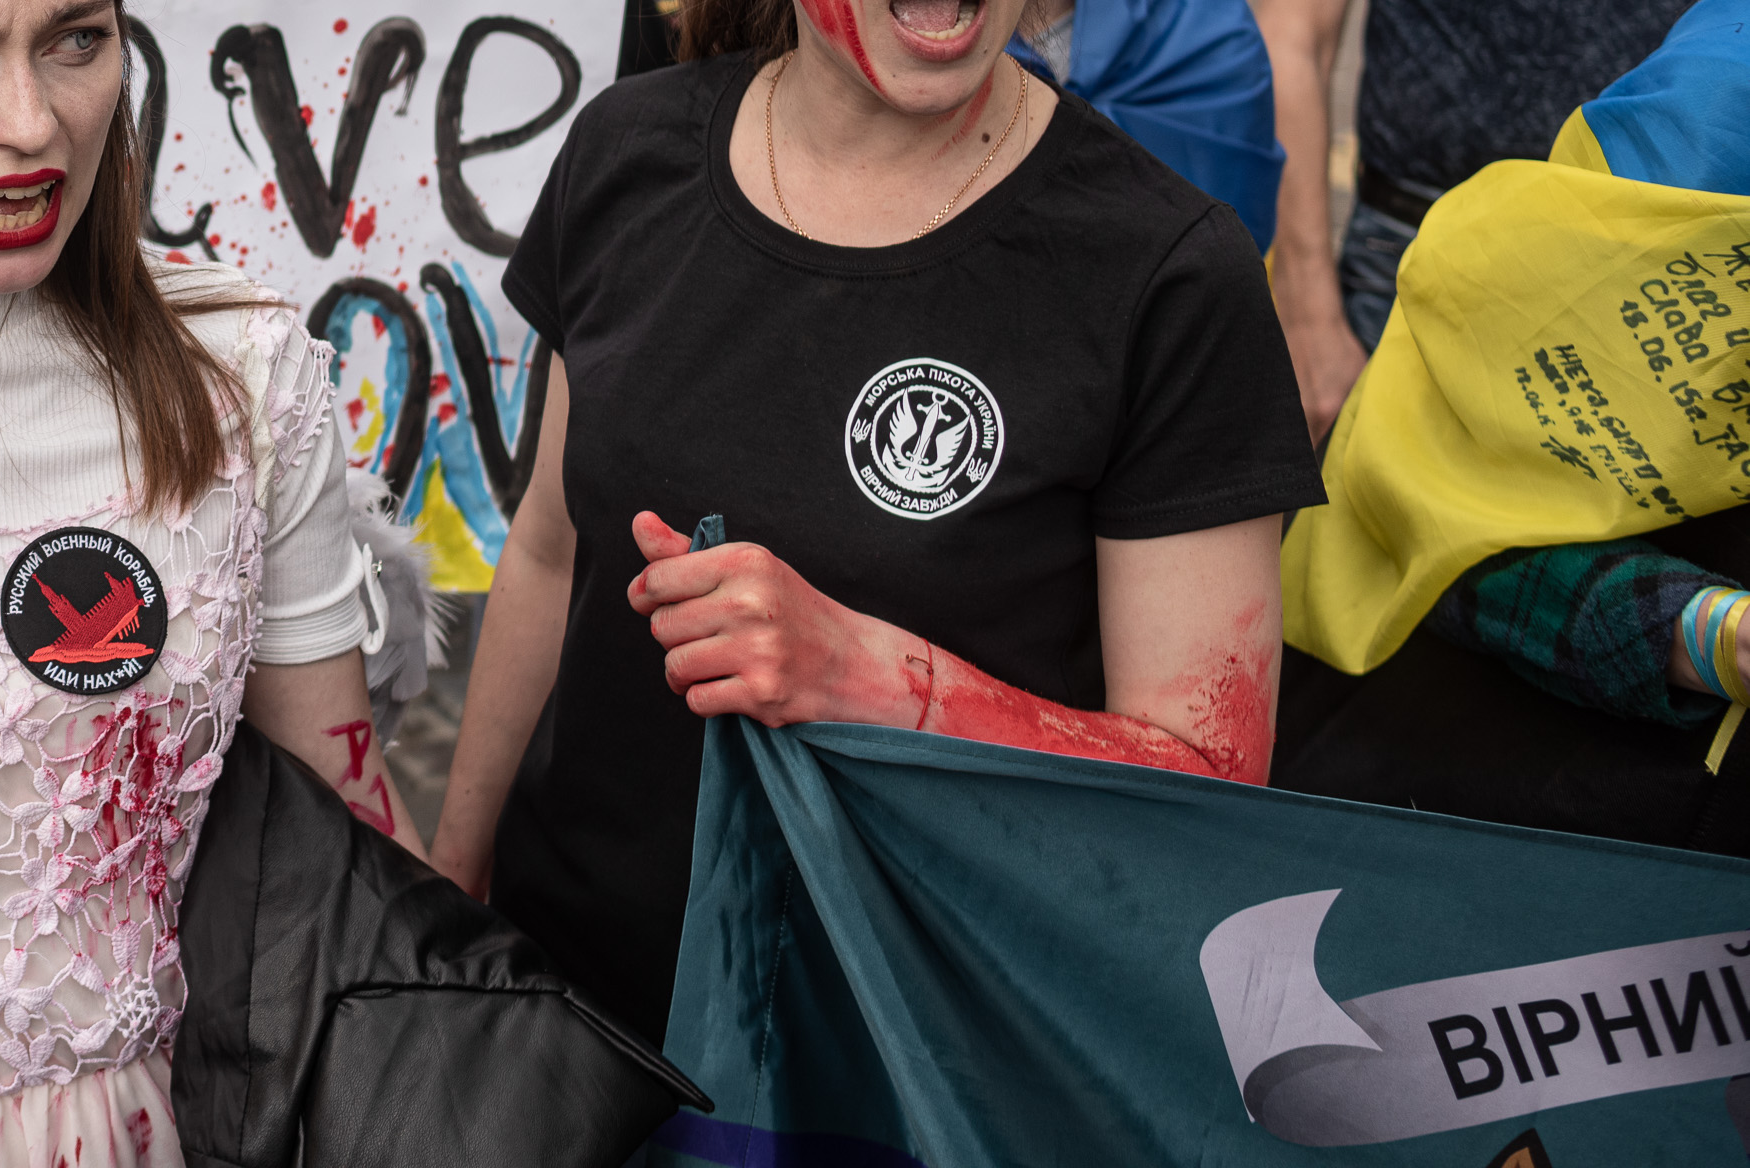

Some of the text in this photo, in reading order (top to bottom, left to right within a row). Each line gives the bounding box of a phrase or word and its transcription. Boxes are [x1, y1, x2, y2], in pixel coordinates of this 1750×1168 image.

[864, 367, 997, 450] МОРСЬКА ПІХОТА УКРАЇНИ
[860, 464, 958, 512] ВІРНИЙ ЗАВЖДИ
[7, 534, 158, 615] РУССКИЙ ВОЕННЫЙ КОРАБЛЬ,
[44, 661, 79, 688] ИДИ
